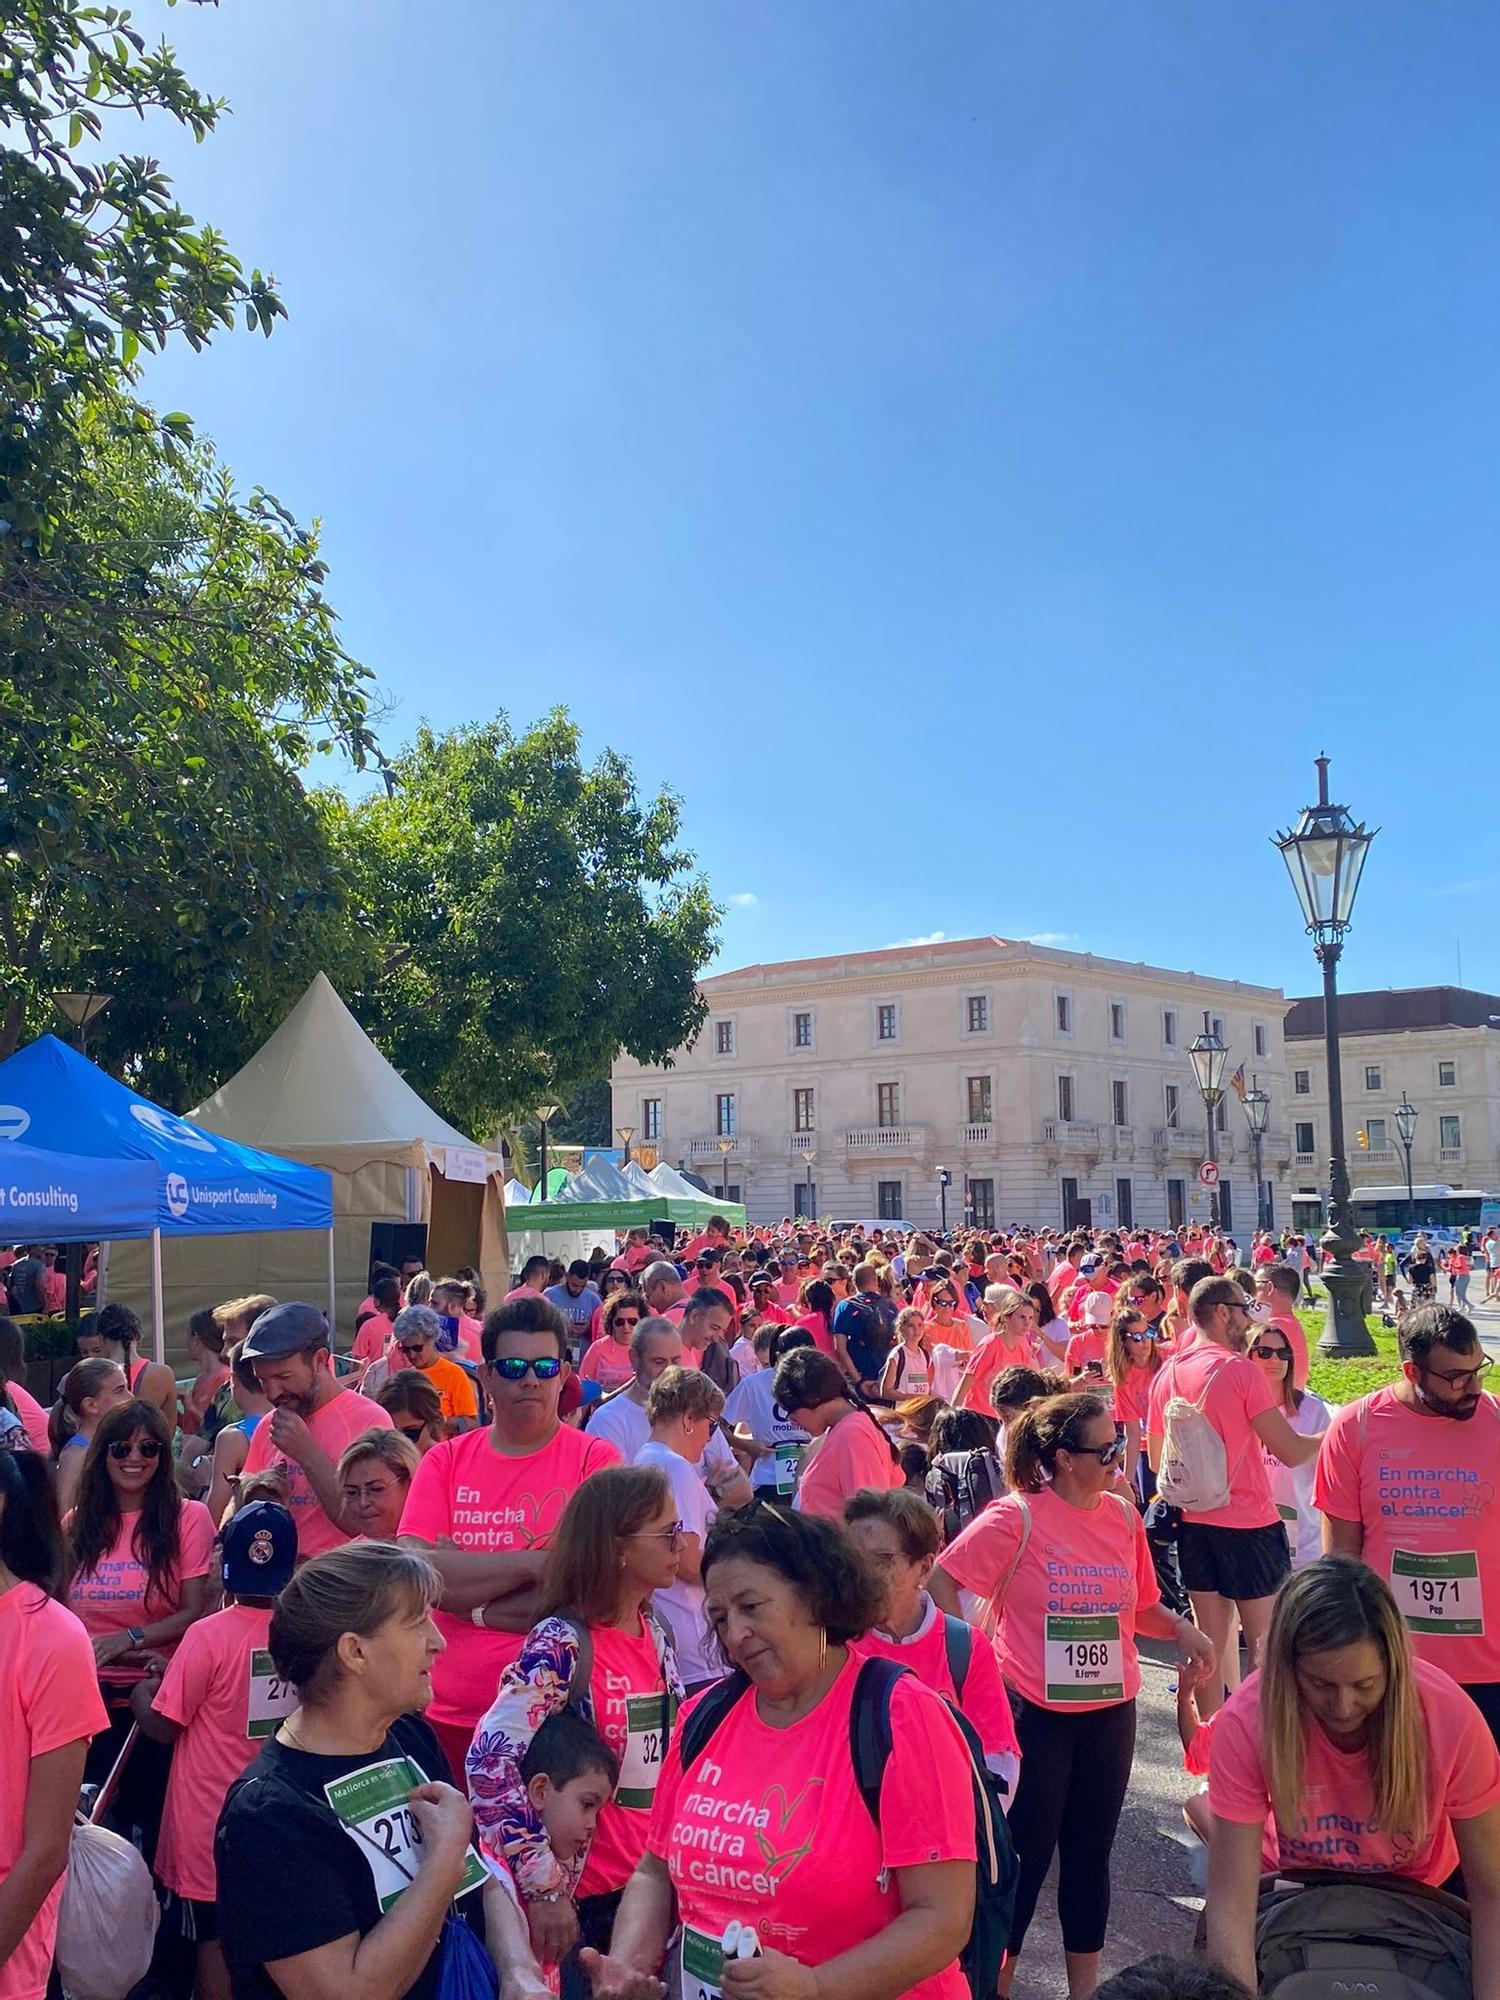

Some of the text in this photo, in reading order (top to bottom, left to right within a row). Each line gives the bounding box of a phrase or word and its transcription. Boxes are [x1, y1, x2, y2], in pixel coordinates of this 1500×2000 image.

[10, 1185, 78, 1213] Consulting
[192, 1188, 278, 1209] Unisport Consulting
[1379, 1467, 1479, 1483] En marcha
[456, 1486, 481, 1504] En
[1379, 1484, 1440, 1499] contra
[453, 1507, 526, 1525] marcha
[1381, 1502, 1468, 1518] el cáncer
[452, 1528, 514, 1546] contra
[1047, 1562, 1130, 1579] En marcha
[1048, 1580, 1103, 1596] contra
[1409, 1579, 1460, 1602] 1971
[1048, 1597, 1065, 1612] el
[1429, 1604, 1444, 1616] Pep
[1065, 1643, 1108, 1666] 1968
[267, 1677, 297, 1701] 27
[333, 1779, 370, 1800] Mallorca
[683, 1790, 772, 1829] marcha
[1315, 1812, 1379, 1834] marc
[671, 1821, 747, 1858] contra
[667, 1850, 685, 1879] el
[688, 1856, 780, 1897] cáncer
[1331, 1981, 1380, 1993] nuna
